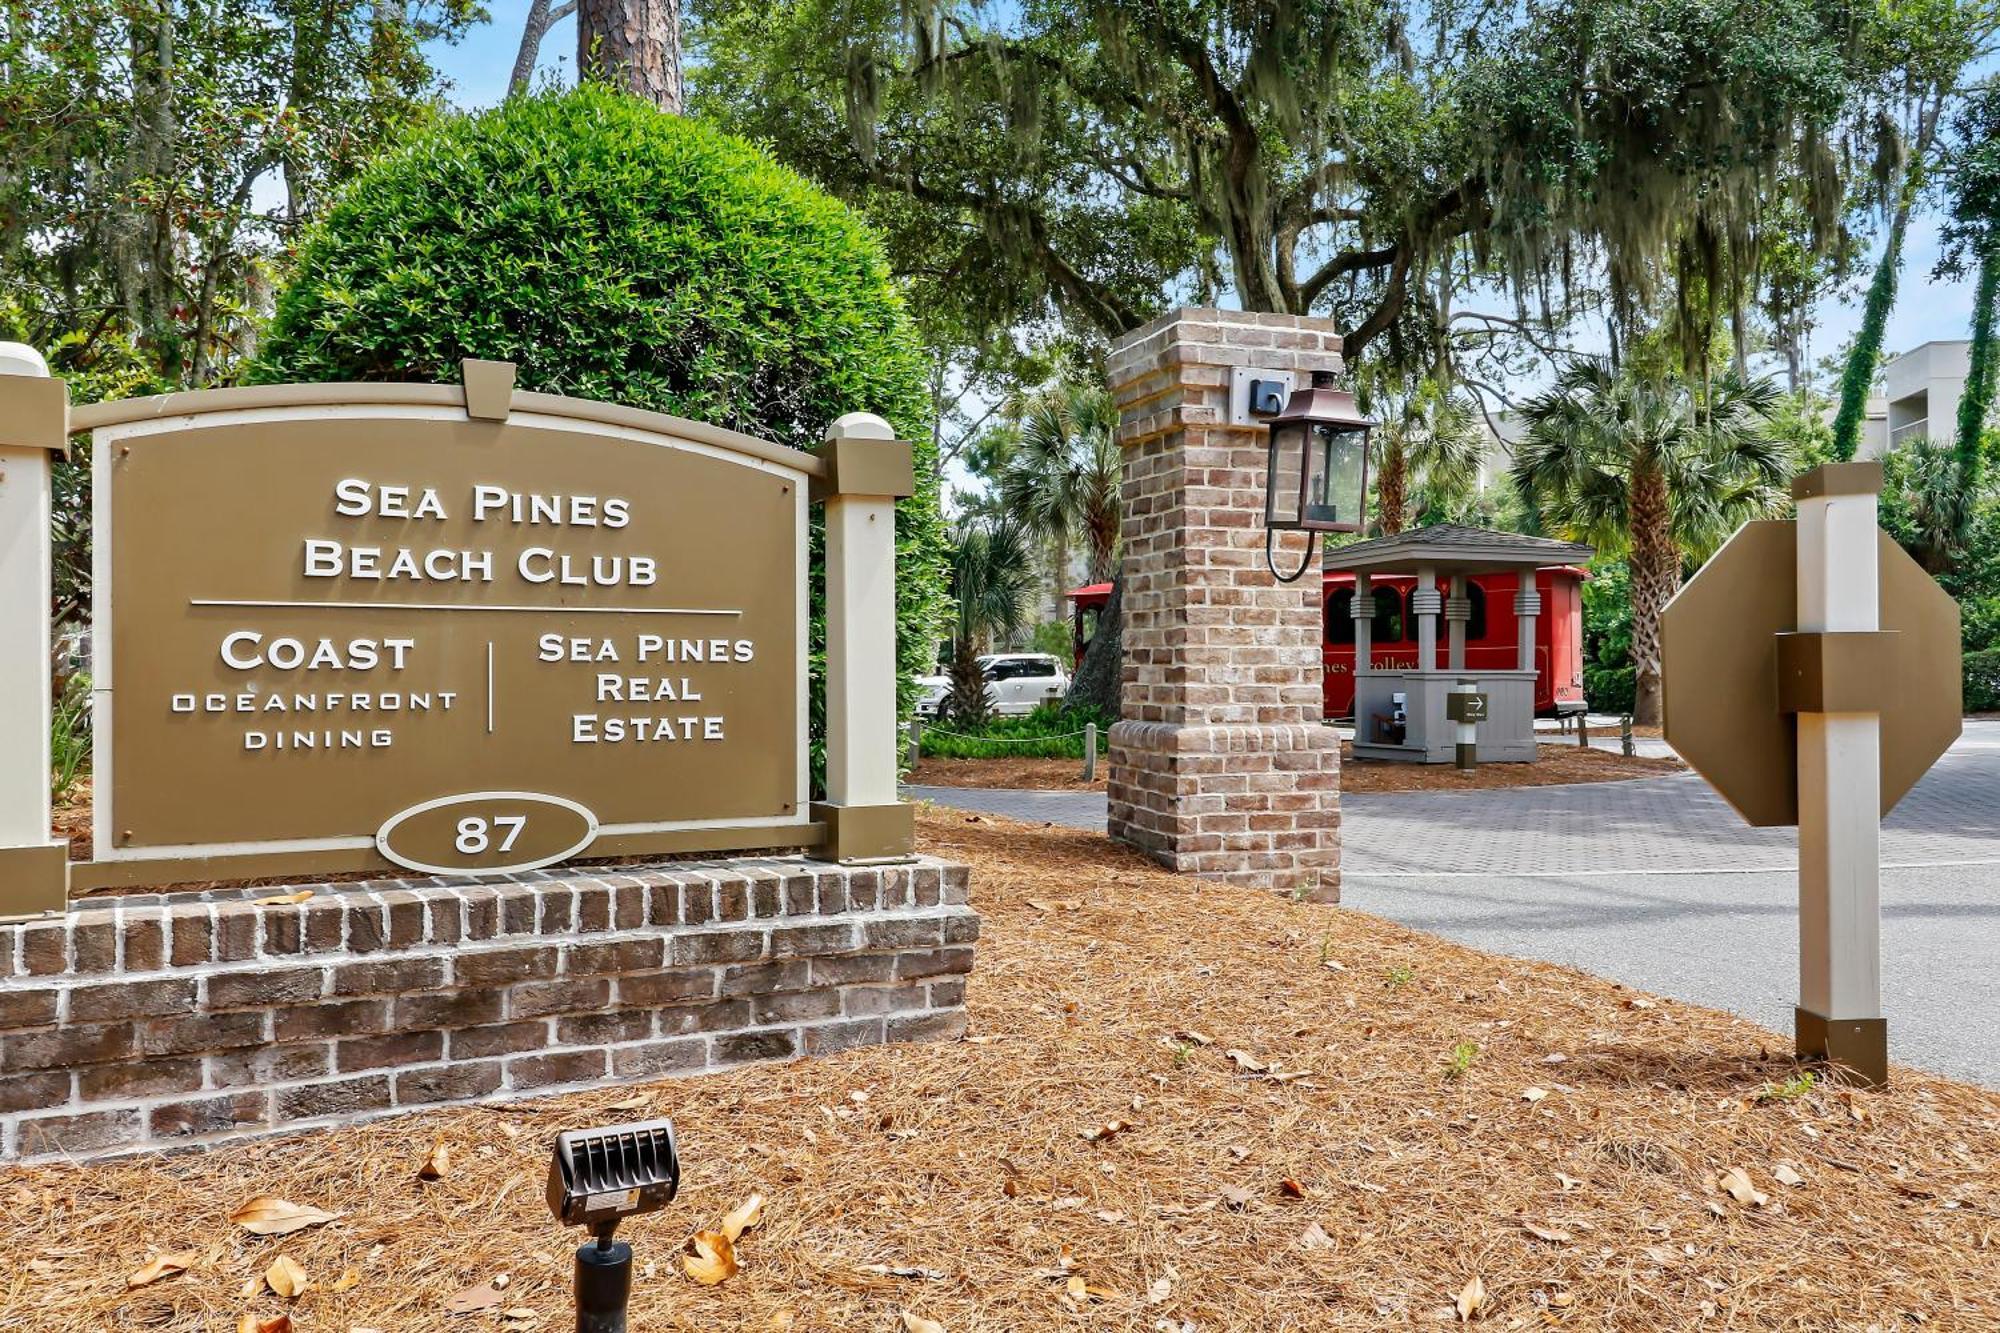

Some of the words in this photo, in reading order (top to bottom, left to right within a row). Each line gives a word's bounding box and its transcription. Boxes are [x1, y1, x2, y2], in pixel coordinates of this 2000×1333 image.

[335, 478, 448, 519] SEA
[474, 484, 630, 528] PINES
[304, 538, 494, 581] BEACH
[518, 547, 657, 586] CLUB
[220, 630, 415, 670] COAST
[538, 633, 620, 662] SEA
[638, 634, 755, 663] PINES
[171, 691, 458, 712] OCEANFRONT
[597, 673, 702, 701] REAL
[244, 729, 393, 749] DINING
[572, 714, 725, 742] ESTATE
[455, 815, 527, 854] 87
